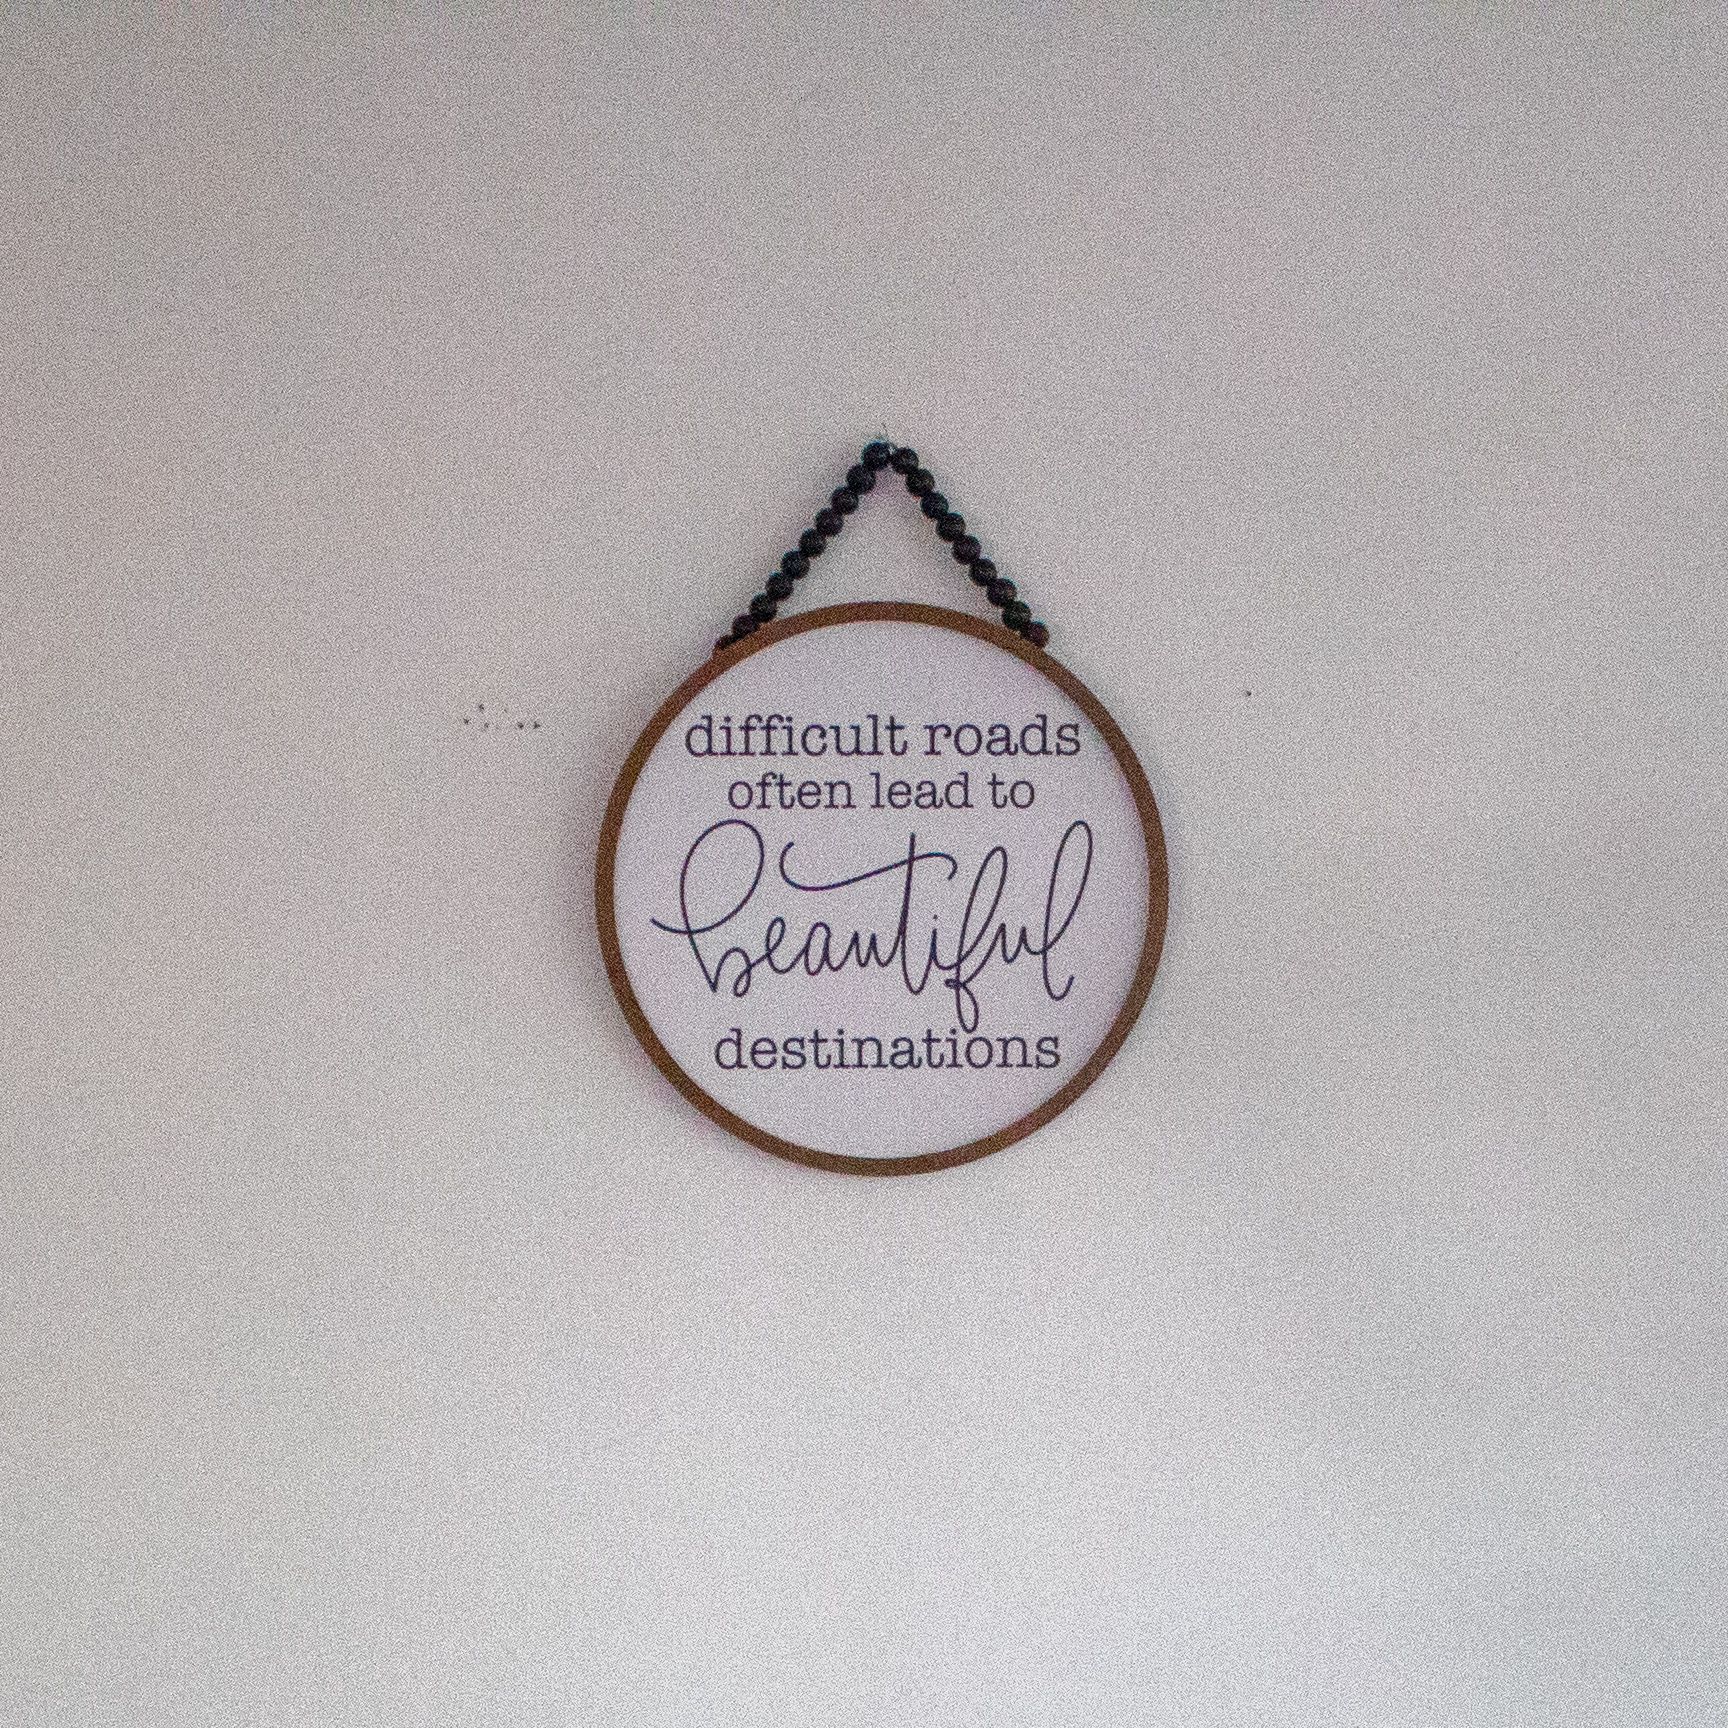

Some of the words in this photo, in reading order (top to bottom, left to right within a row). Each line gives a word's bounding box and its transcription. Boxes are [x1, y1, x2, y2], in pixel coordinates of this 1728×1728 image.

[685, 714, 908, 757] difficult
[923, 714, 1081, 757] roads
[728, 772, 857, 810] often
[871, 772, 973, 810] lead
[988, 776, 1035, 809] to
[651, 818, 1093, 1032] beautiful
[714, 1027, 1061, 1070] destinations
